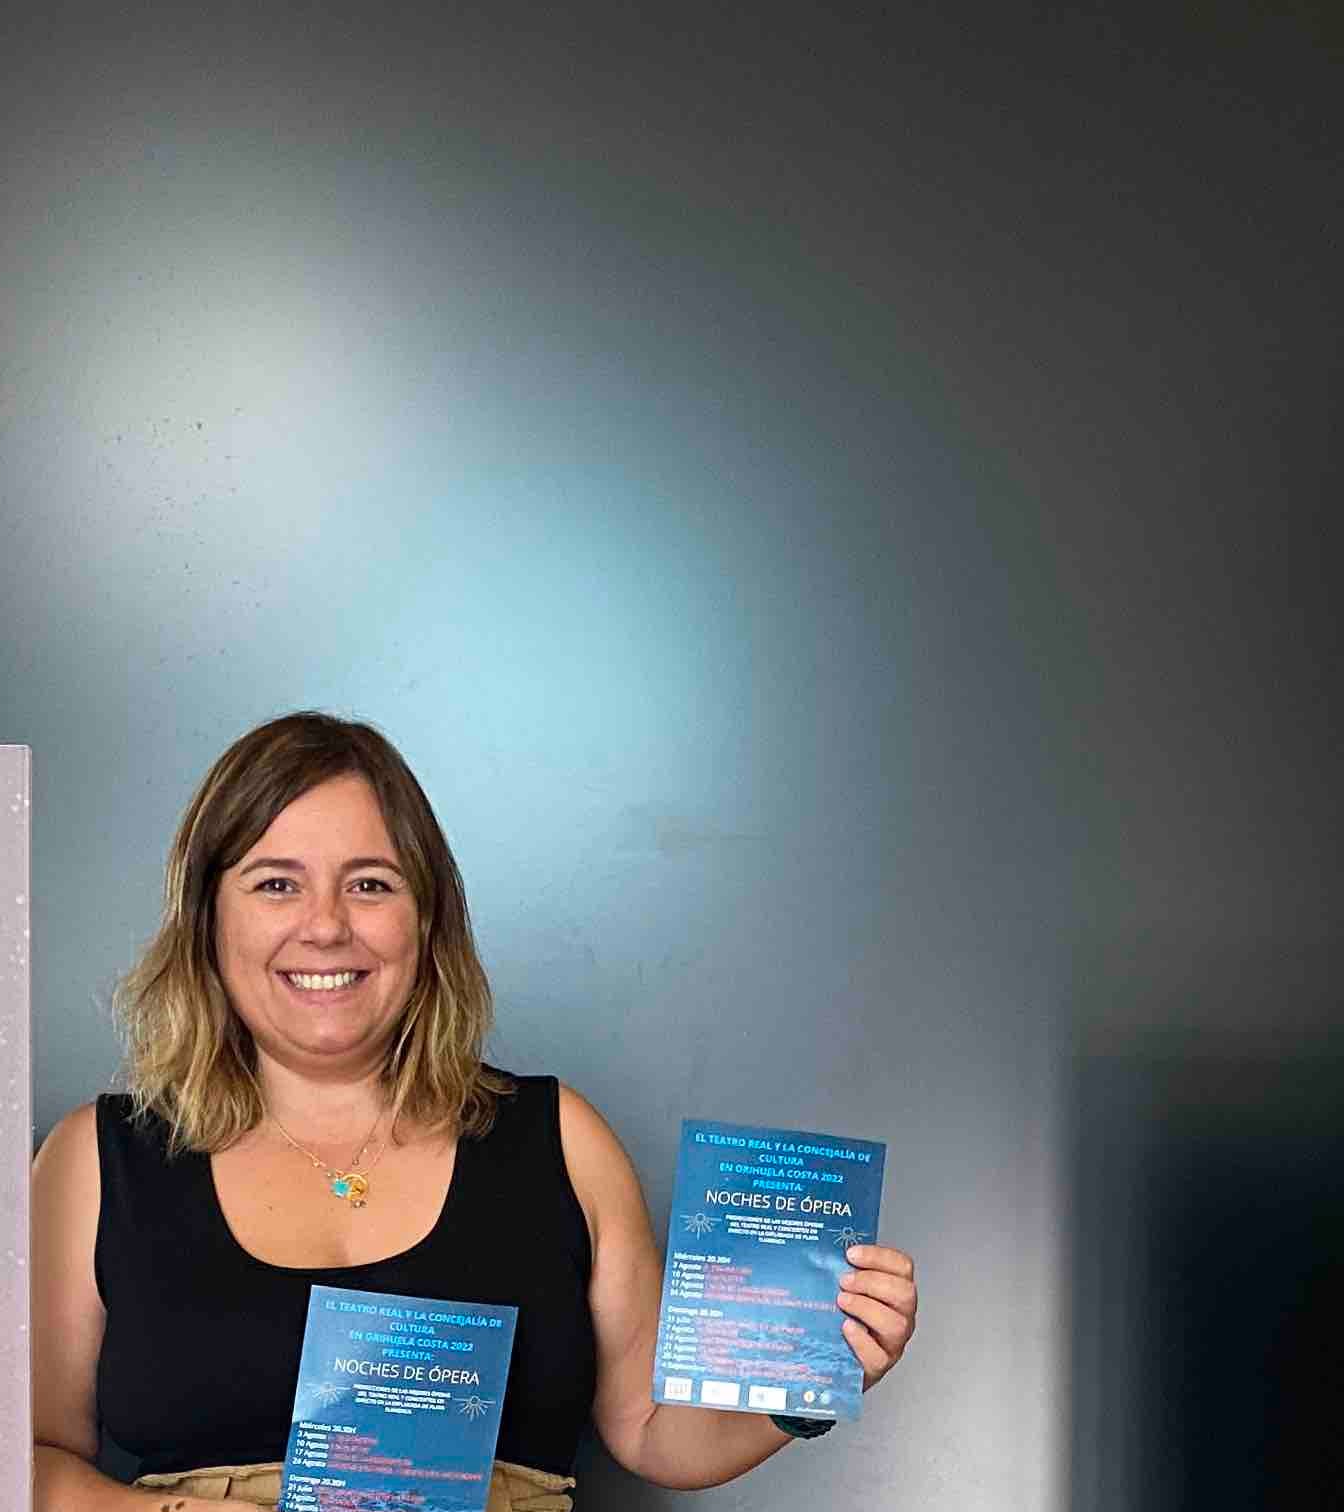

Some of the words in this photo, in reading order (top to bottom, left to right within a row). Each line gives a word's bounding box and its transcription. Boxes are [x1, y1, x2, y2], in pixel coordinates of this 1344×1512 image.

[709, 1135, 745, 1147] TEATRO
[748, 1140, 772, 1150] REAL
[775, 1143, 782, 1151] Y
[783, 1143, 795, 1152] LA
[858, 1153, 871, 1162] DE
[759, 1154, 804, 1165] CULTURA
[787, 1170, 818, 1180] COSTA
[821, 1173, 843, 1183] 2022
[706, 1190, 770, 1208] NOCHES
[776, 1196, 796, 1211] DE
[801, 1196, 852, 1216] ÓPERA
[339, 1302, 376, 1313] TEATRO
[415, 1311, 426, 1320] LA
[490, 1320, 502, 1328] DE
[390, 1322, 435, 1334] CULTURA
[417, 1338, 448, 1349] COSTA
[451, 1342, 473, 1351] 2022
[334, 1358, 399, 1378] NOCHES
[404, 1366, 425, 1381] DE
[429, 1365, 480, 1386] ÓPERA
